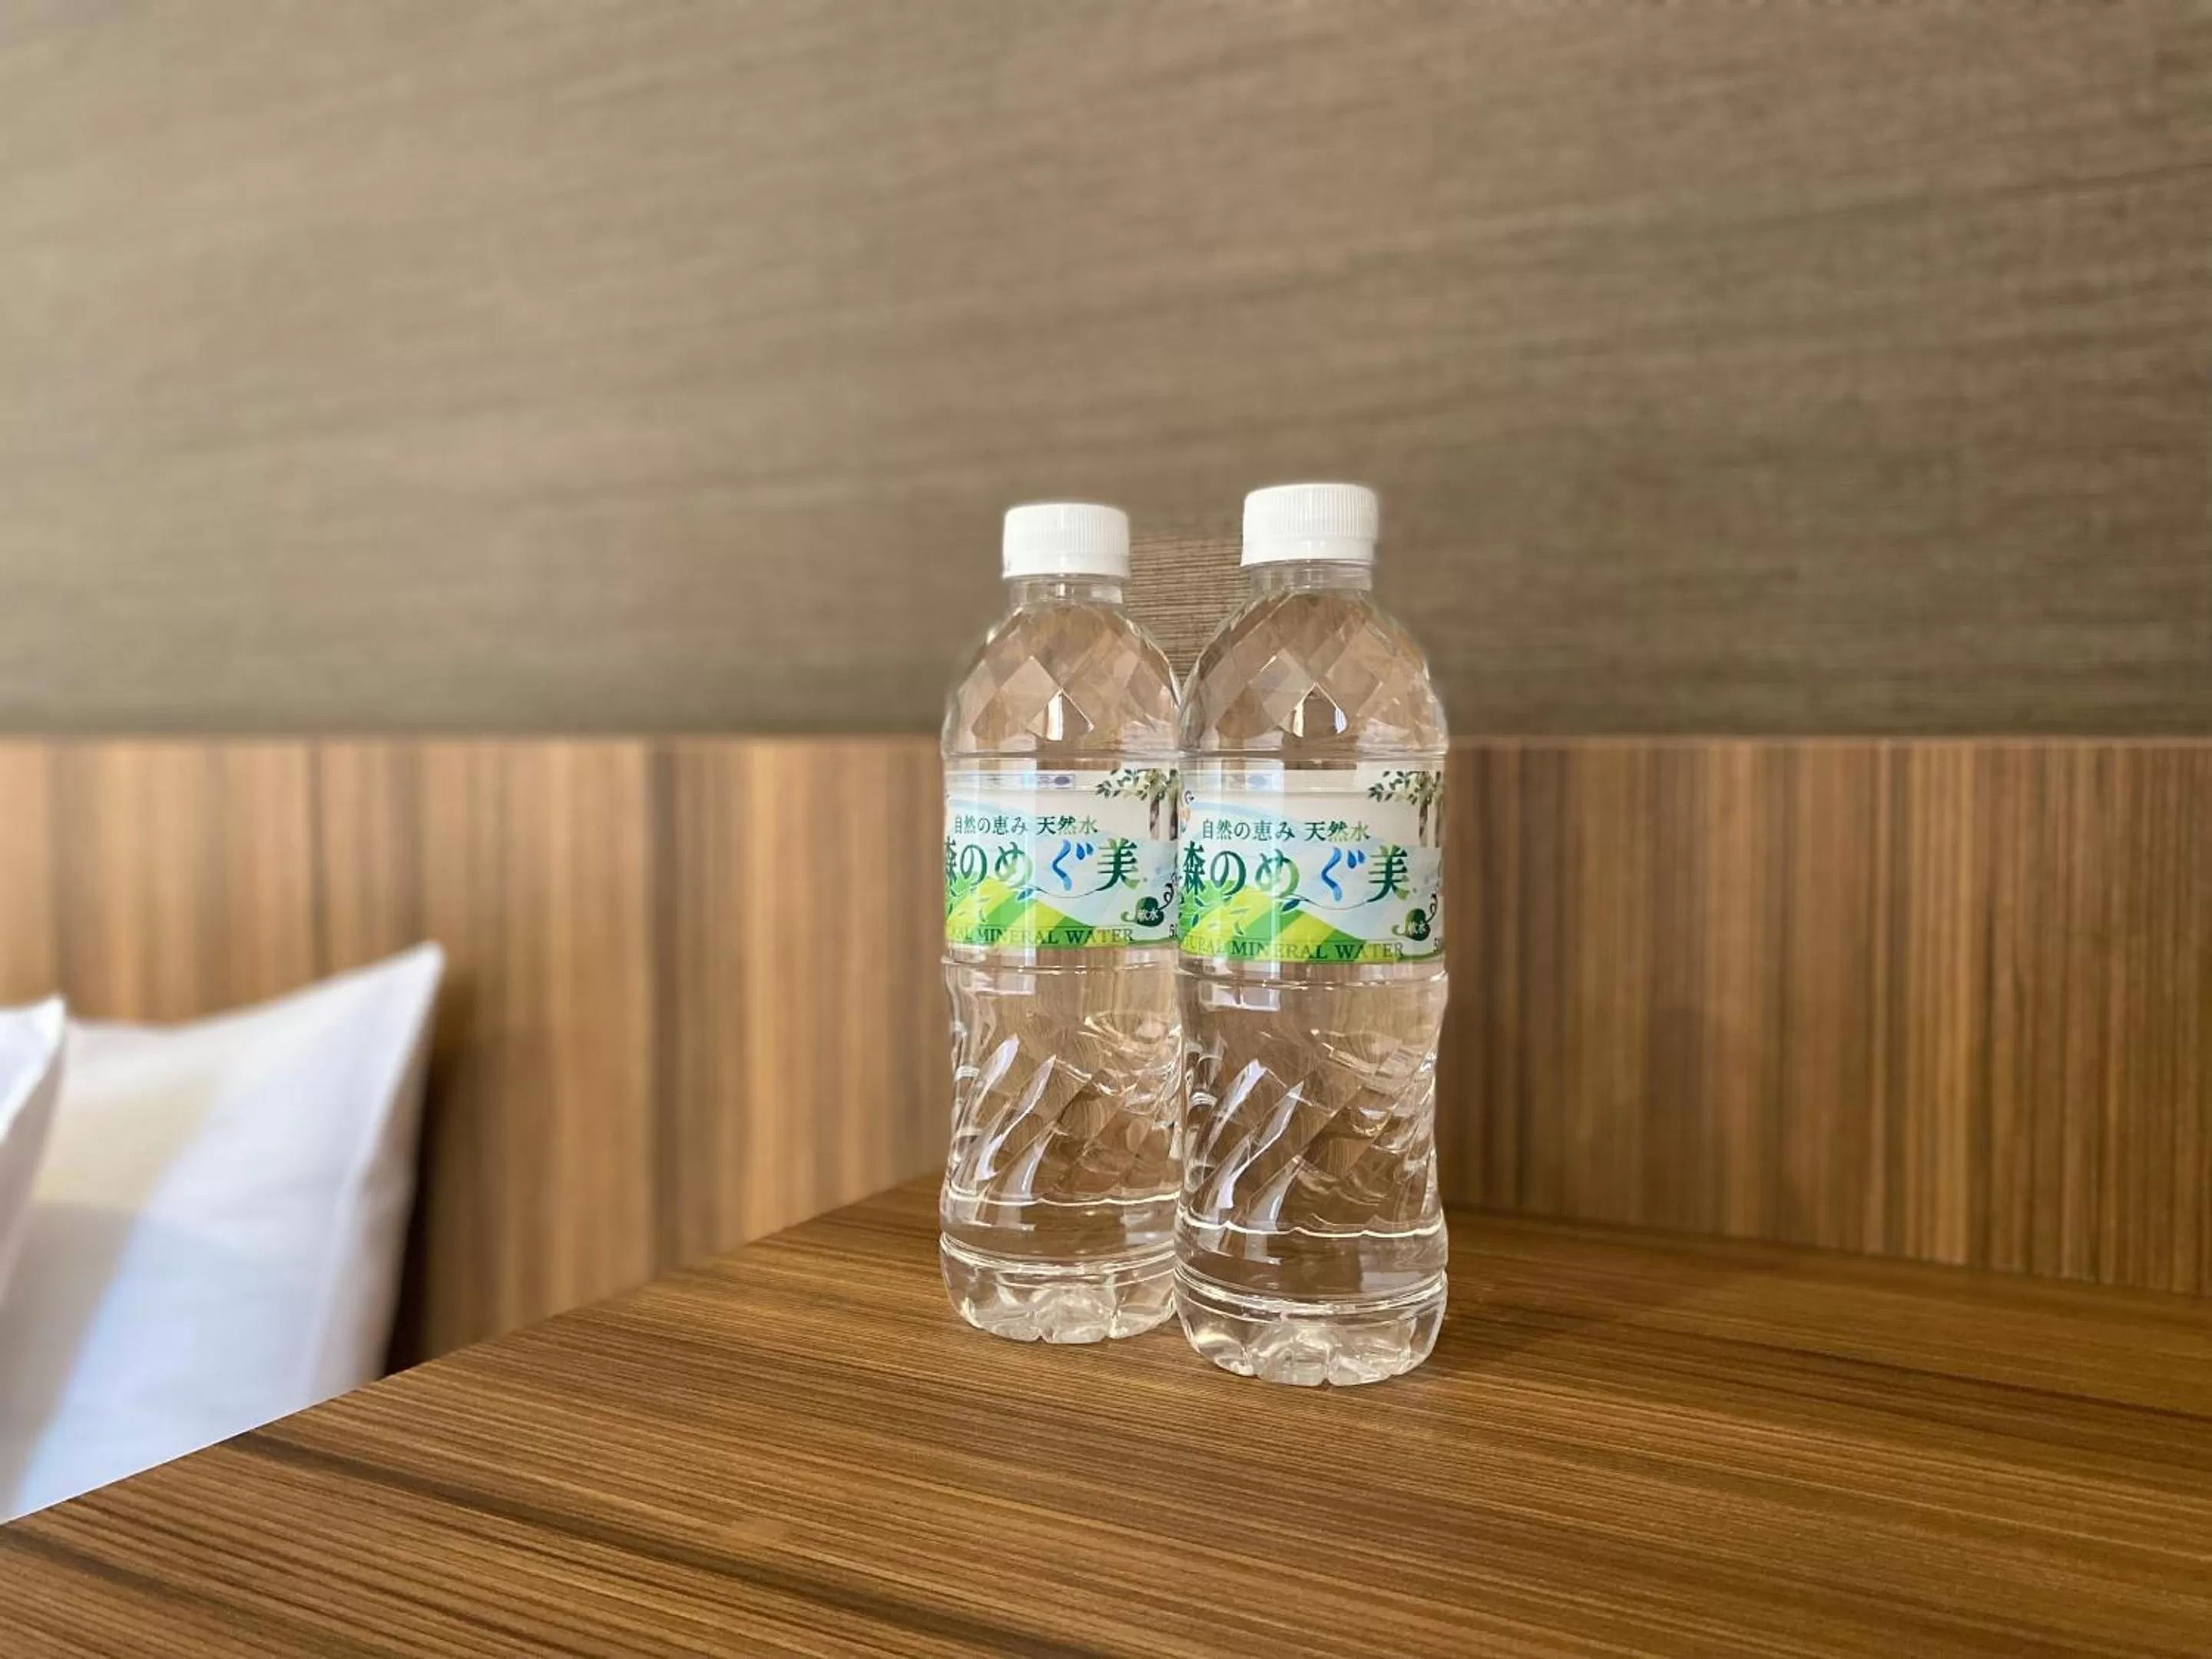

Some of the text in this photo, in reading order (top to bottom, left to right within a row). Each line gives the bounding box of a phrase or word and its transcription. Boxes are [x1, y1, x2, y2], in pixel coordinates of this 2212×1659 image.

[955, 816, 1098, 836] 自然の恵み 天然水
[1202, 819, 1371, 842] 自然の恵み 天然水
[1183, 841, 1409, 902] 森のめぐ美
[978, 928, 1058, 945] MINERAL
[1065, 926, 1134, 944] WATER
[1231, 941, 1328, 959] MINERAL
[1335, 943, 1404, 960] WATER
